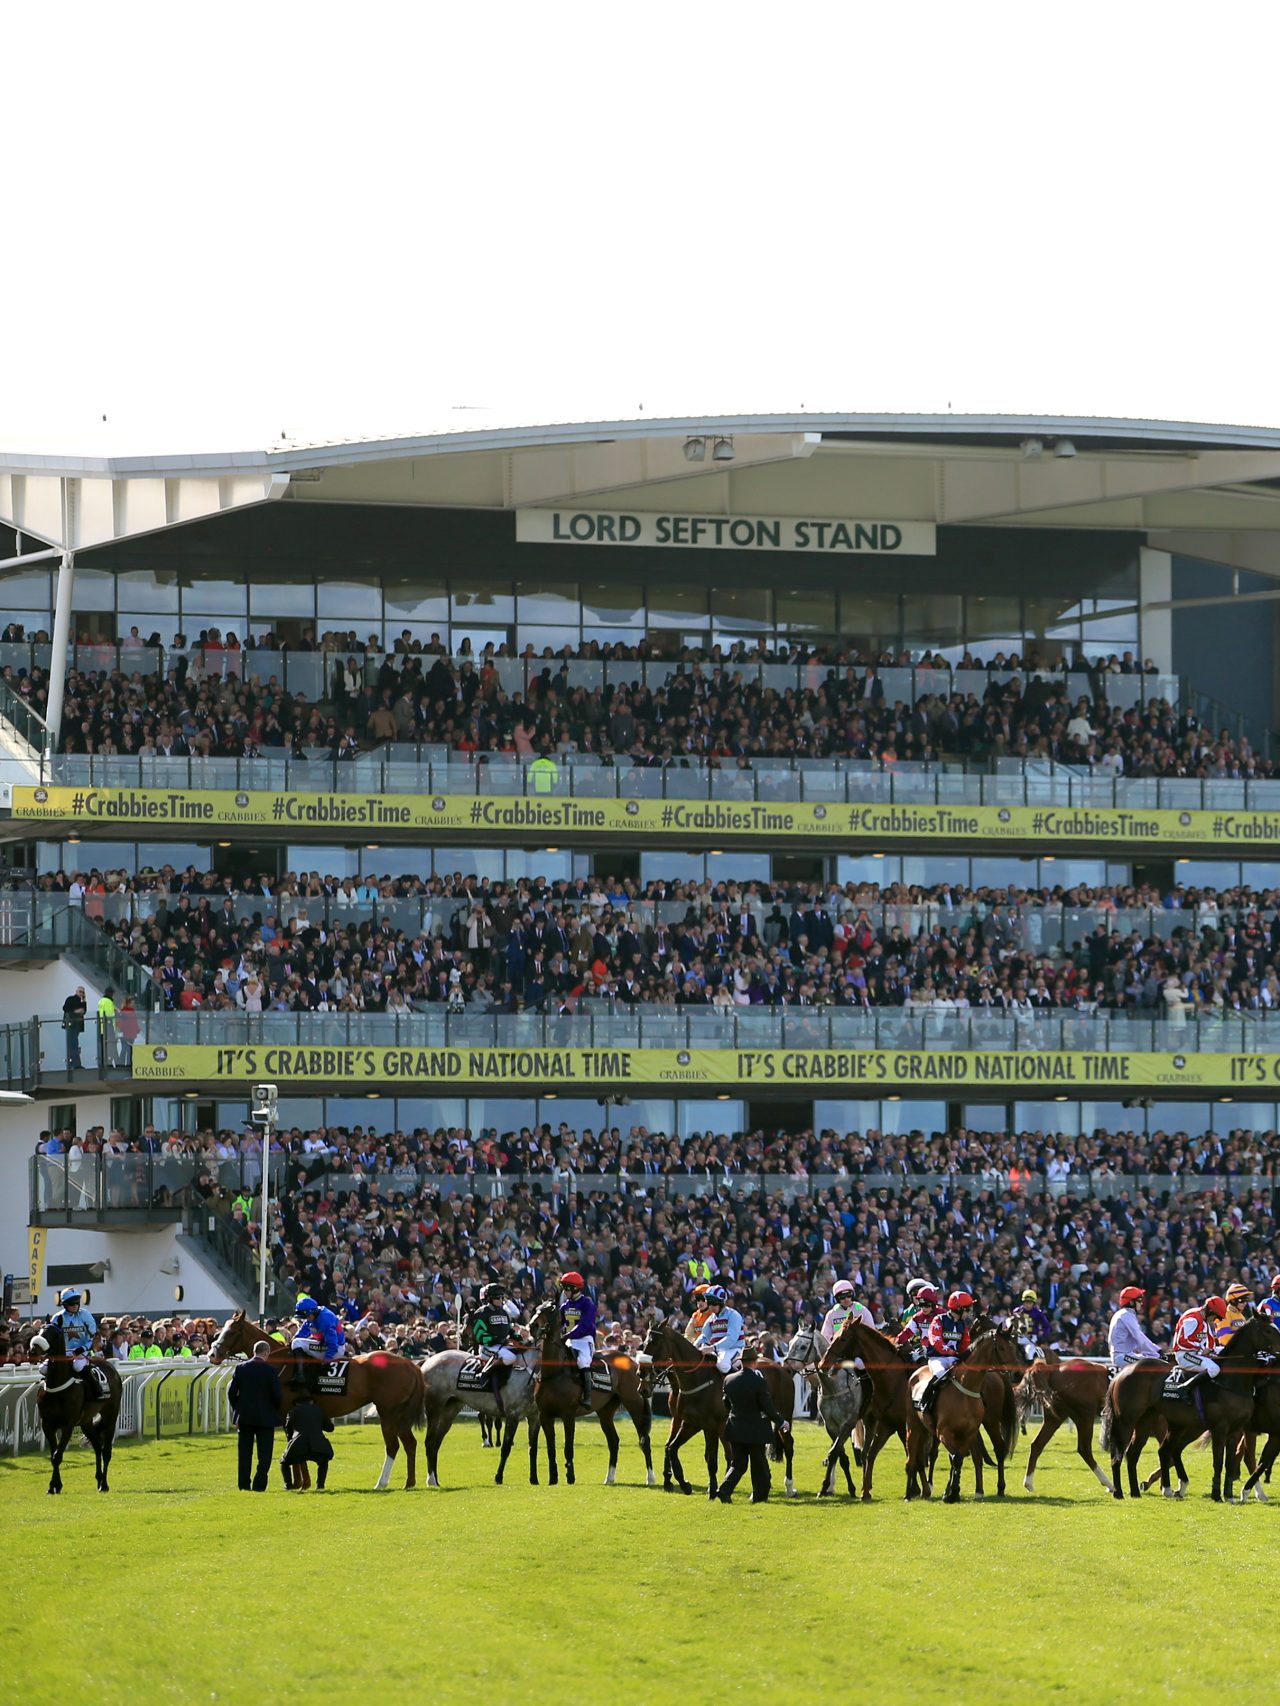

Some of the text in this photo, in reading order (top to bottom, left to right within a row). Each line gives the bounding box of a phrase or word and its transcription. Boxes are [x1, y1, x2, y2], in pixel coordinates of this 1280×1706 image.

[553, 513, 902, 551] LORD SEFTON STAND
[72, 792, 214, 819] #CrabbiesTime
[272, 797, 411, 823] #CrabbiesTime
[470, 801, 605, 827] #CrabbiesTime
[662, 804, 794, 831] #CrabbiesTime
[848, 808, 979, 833] #CrabbiesTime
[1032, 812, 1160, 837] #CrabbiesTime
[217, 1050, 631, 1077] IT'S CRABBIE'S GRAND NATIONAL TIME
[737, 1053, 1130, 1080] IT'S CRABBIE'S GRAND NATIONAL TIME
[1231, 1057, 1266, 1081] IT'S
[31, 1232, 40, 1291] CASH
[327, 1361, 349, 1377] 37
